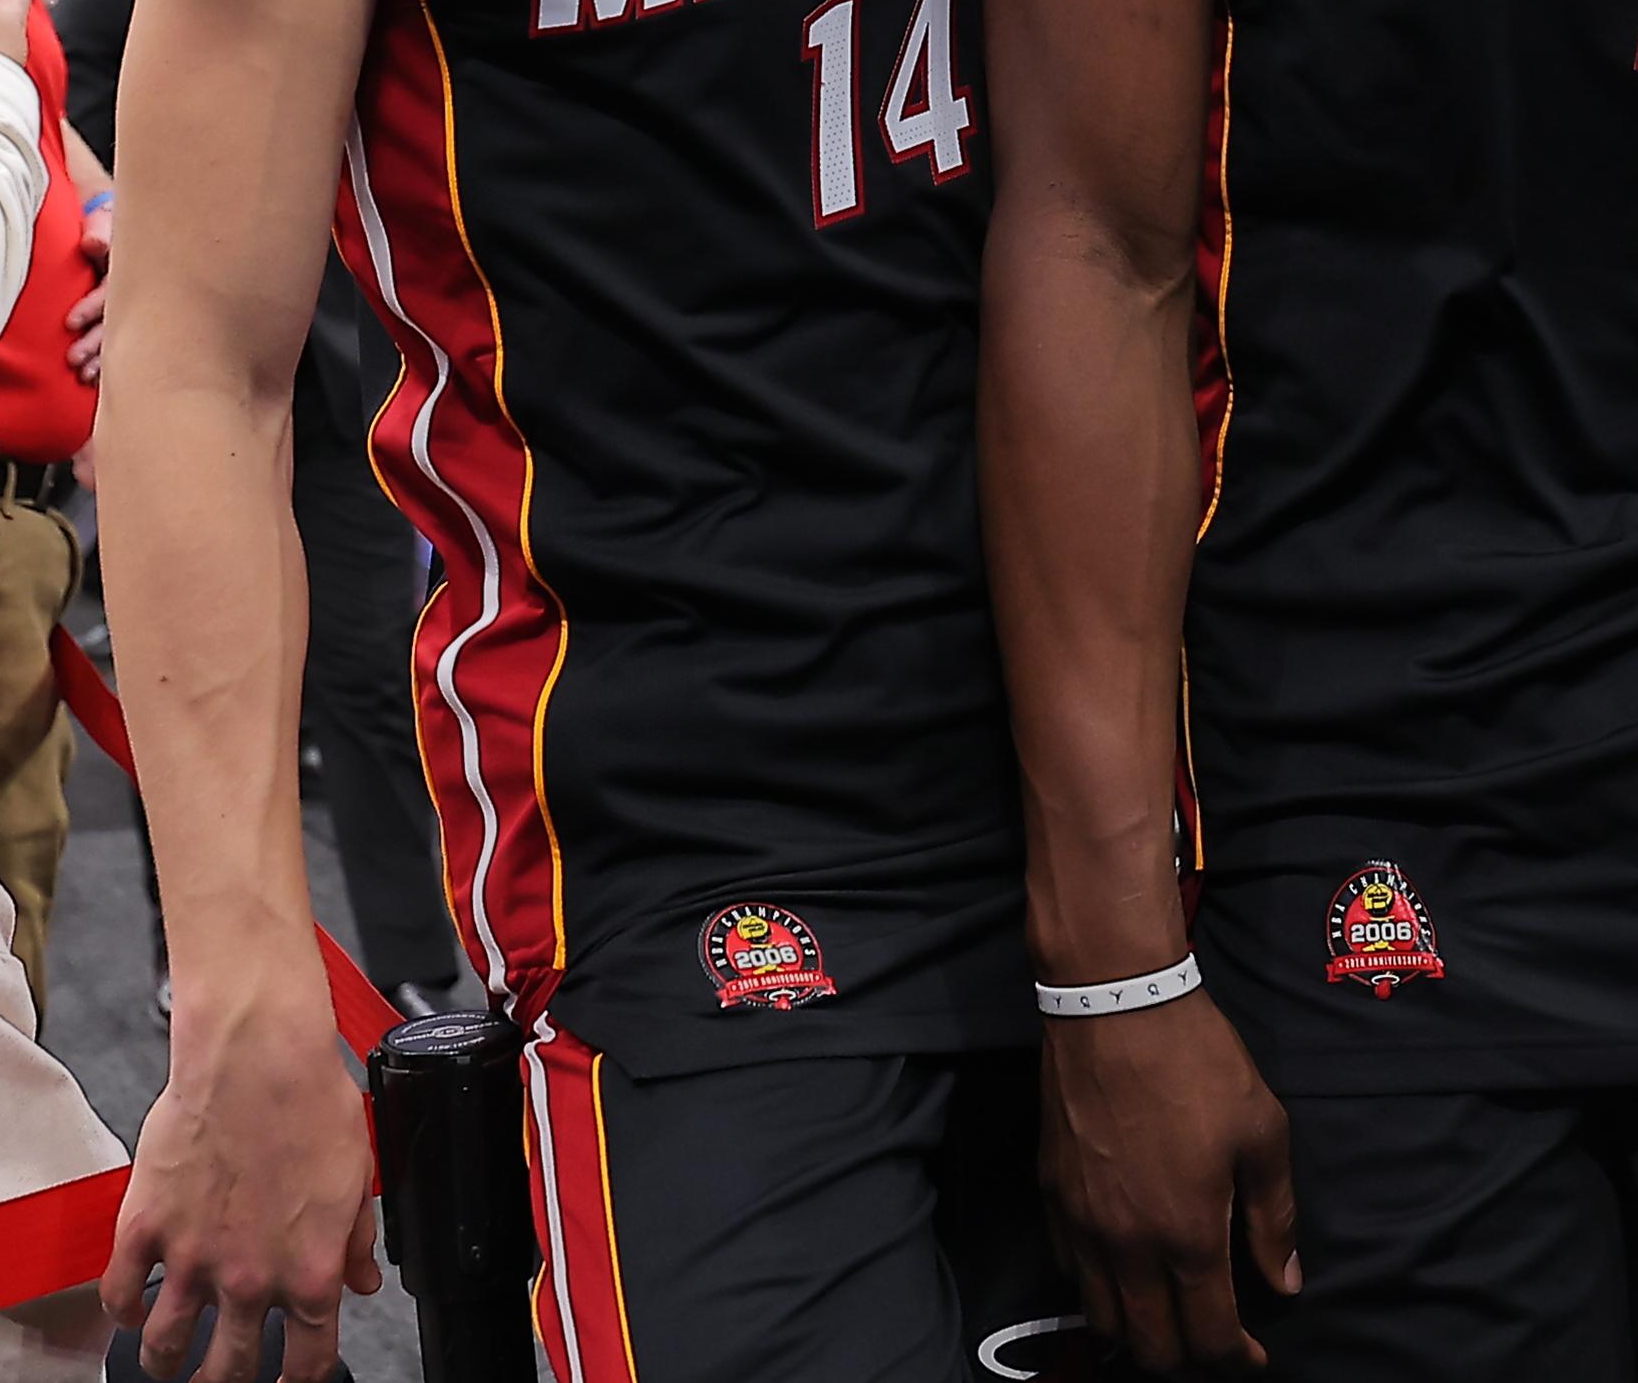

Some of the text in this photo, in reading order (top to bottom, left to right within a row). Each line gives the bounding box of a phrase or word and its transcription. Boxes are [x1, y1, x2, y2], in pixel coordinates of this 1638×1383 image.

[721, 905, 817, 957] CHAMPIONS
[1350, 921, 1413, 943] 2006
[734, 945, 799, 969] 2006
